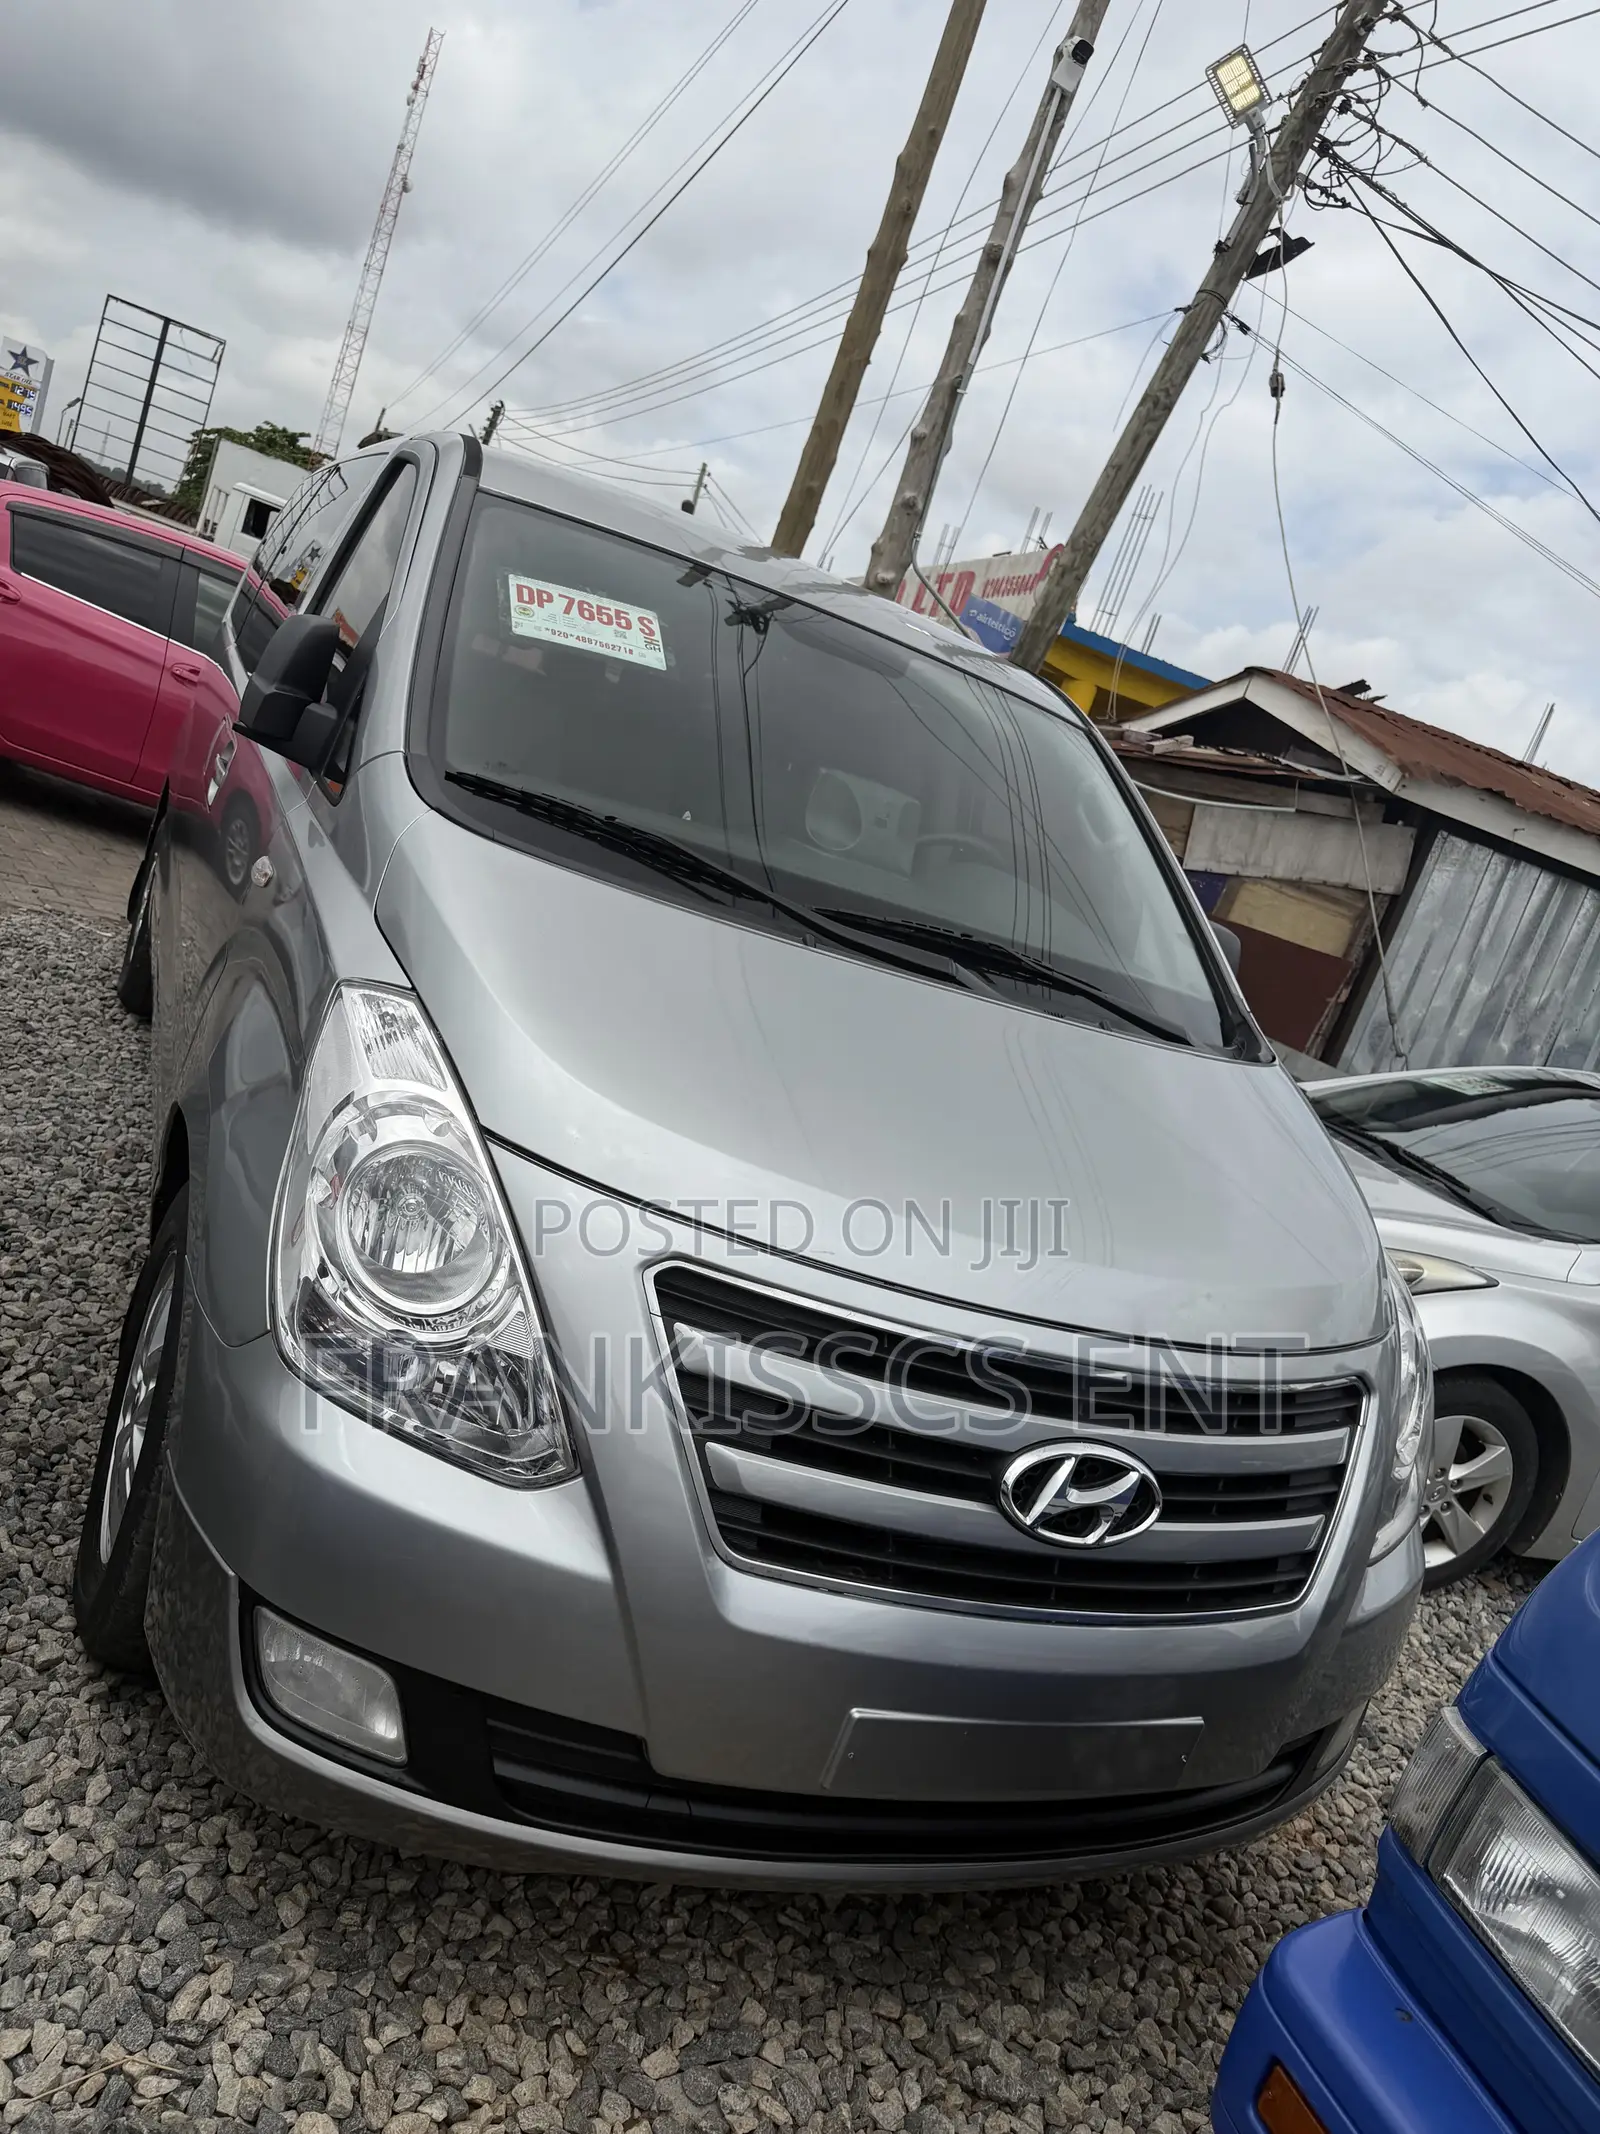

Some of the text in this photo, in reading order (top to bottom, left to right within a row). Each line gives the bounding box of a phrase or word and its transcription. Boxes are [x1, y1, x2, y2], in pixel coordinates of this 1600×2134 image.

[516, 584, 554, 608] DP
[558, 593, 633, 631] 7655
[637, 616, 656, 637] S
[644, 643, 662, 653] GH
